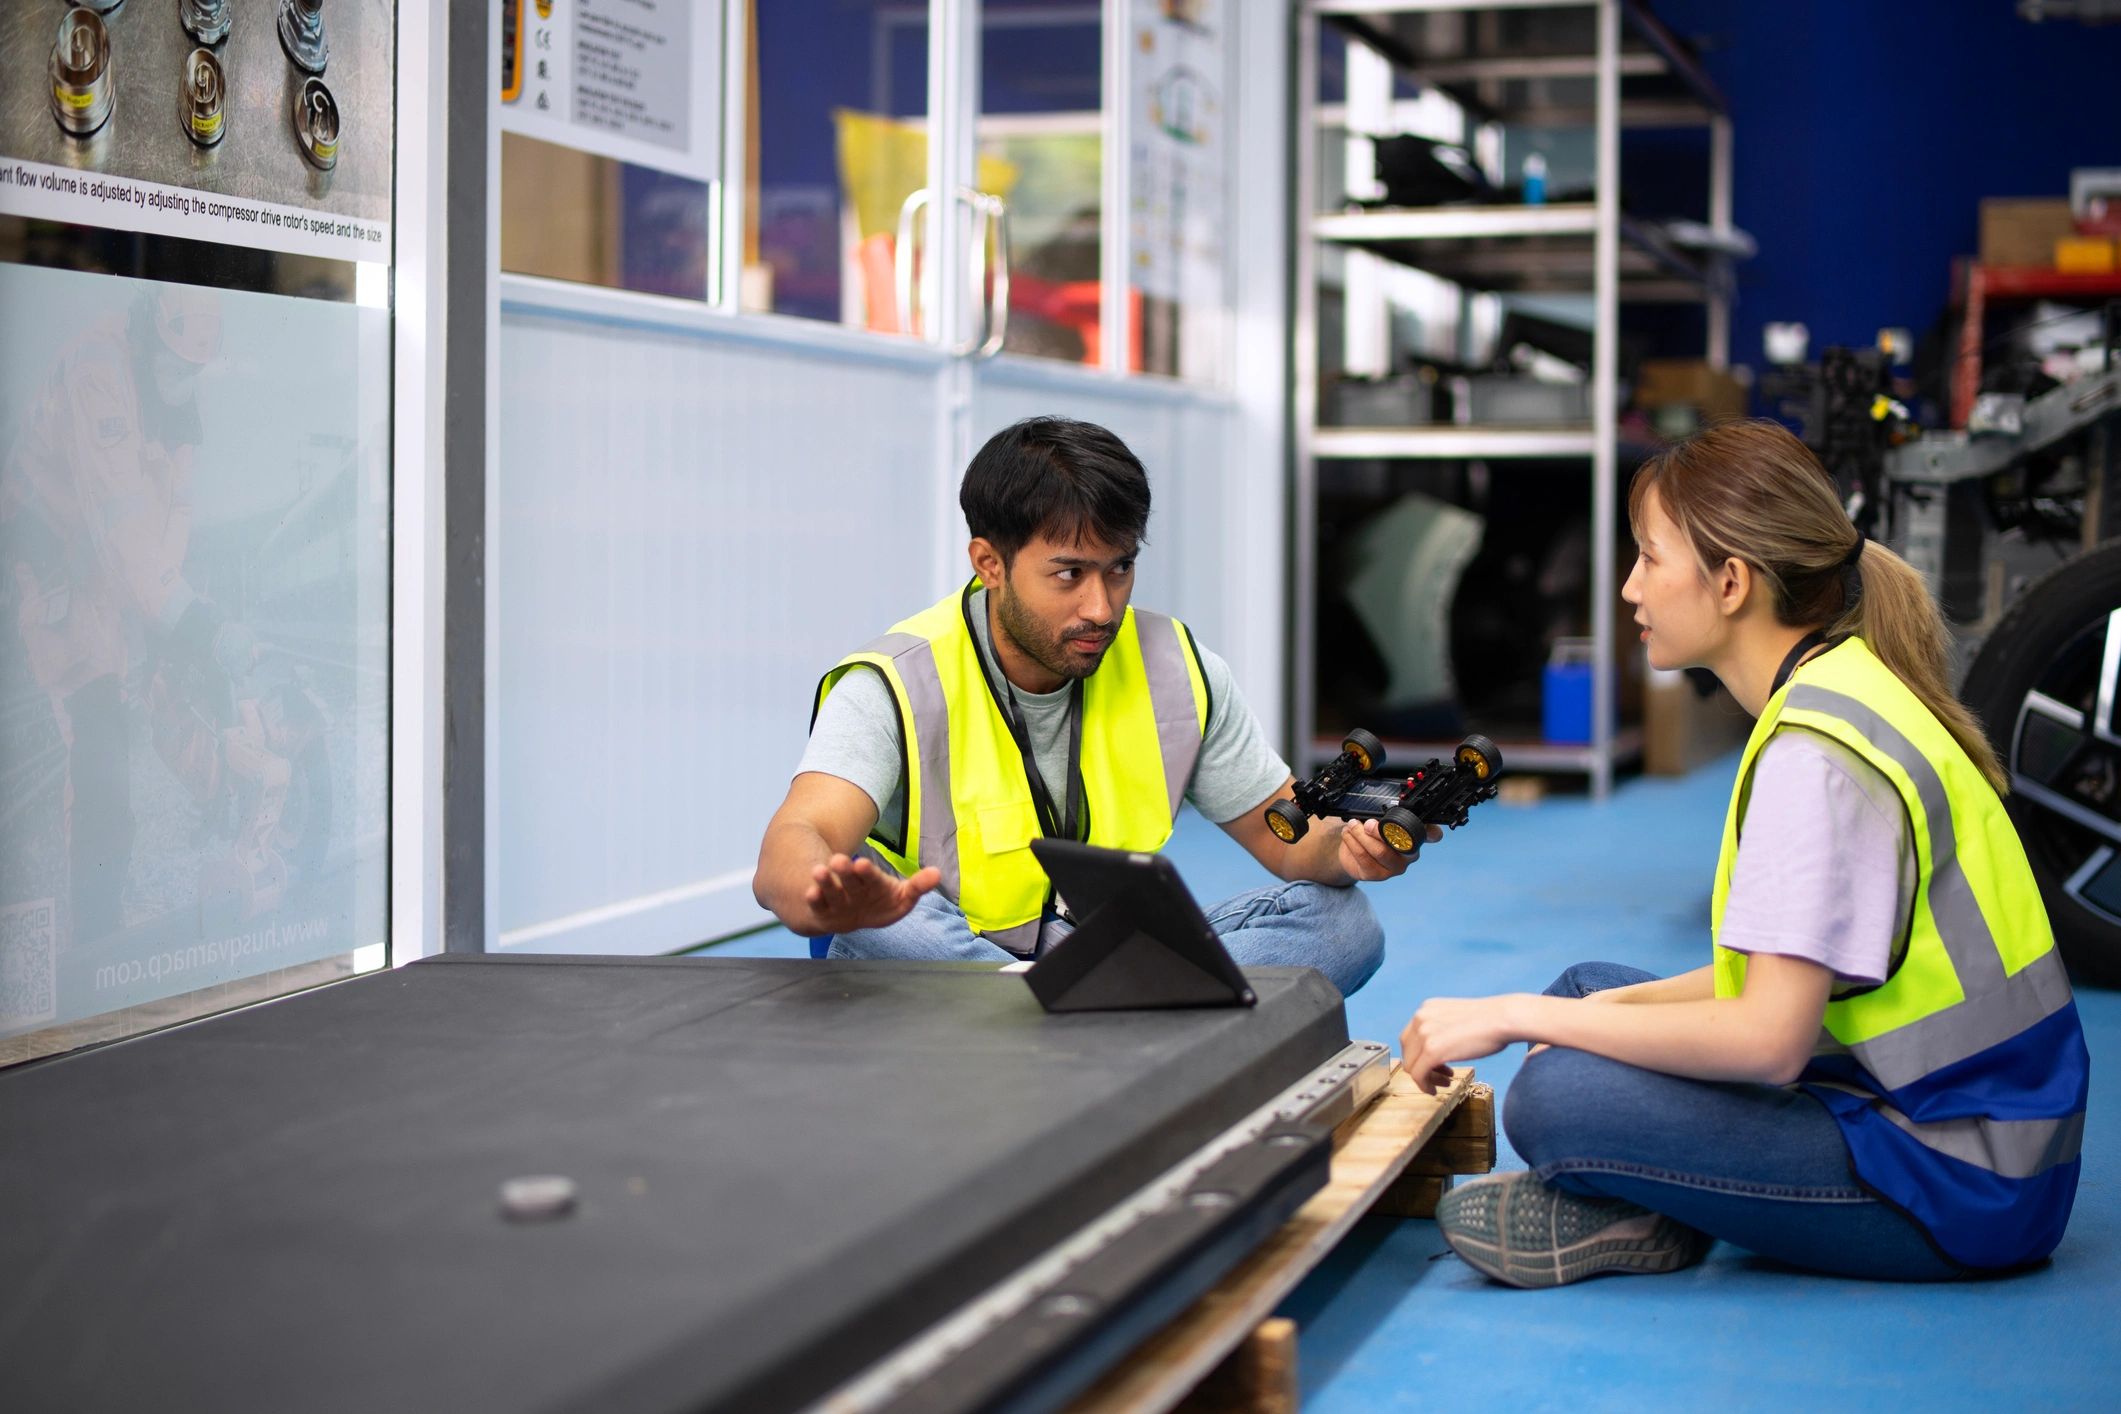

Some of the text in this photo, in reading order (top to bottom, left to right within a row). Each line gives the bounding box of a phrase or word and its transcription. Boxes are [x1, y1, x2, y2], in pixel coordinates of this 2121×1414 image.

[16, 166, 37, 188] flow
[40, 172, 77, 193] volume
[79, 177, 88, 195] is
[91, 182, 132, 203] adjusted
[135, 188, 146, 208] by
[149, 190, 190, 216] adjusting
[192, 197, 206, 214] the
[208, 202, 259, 223] compressor
[261, 208, 281, 226] drive
[283, 214, 309, 231] rotor's
[310, 219, 335, 237] speed
[336, 222, 351, 238] and
[353, 225, 365, 240] the
[366, 228, 382, 243] size
